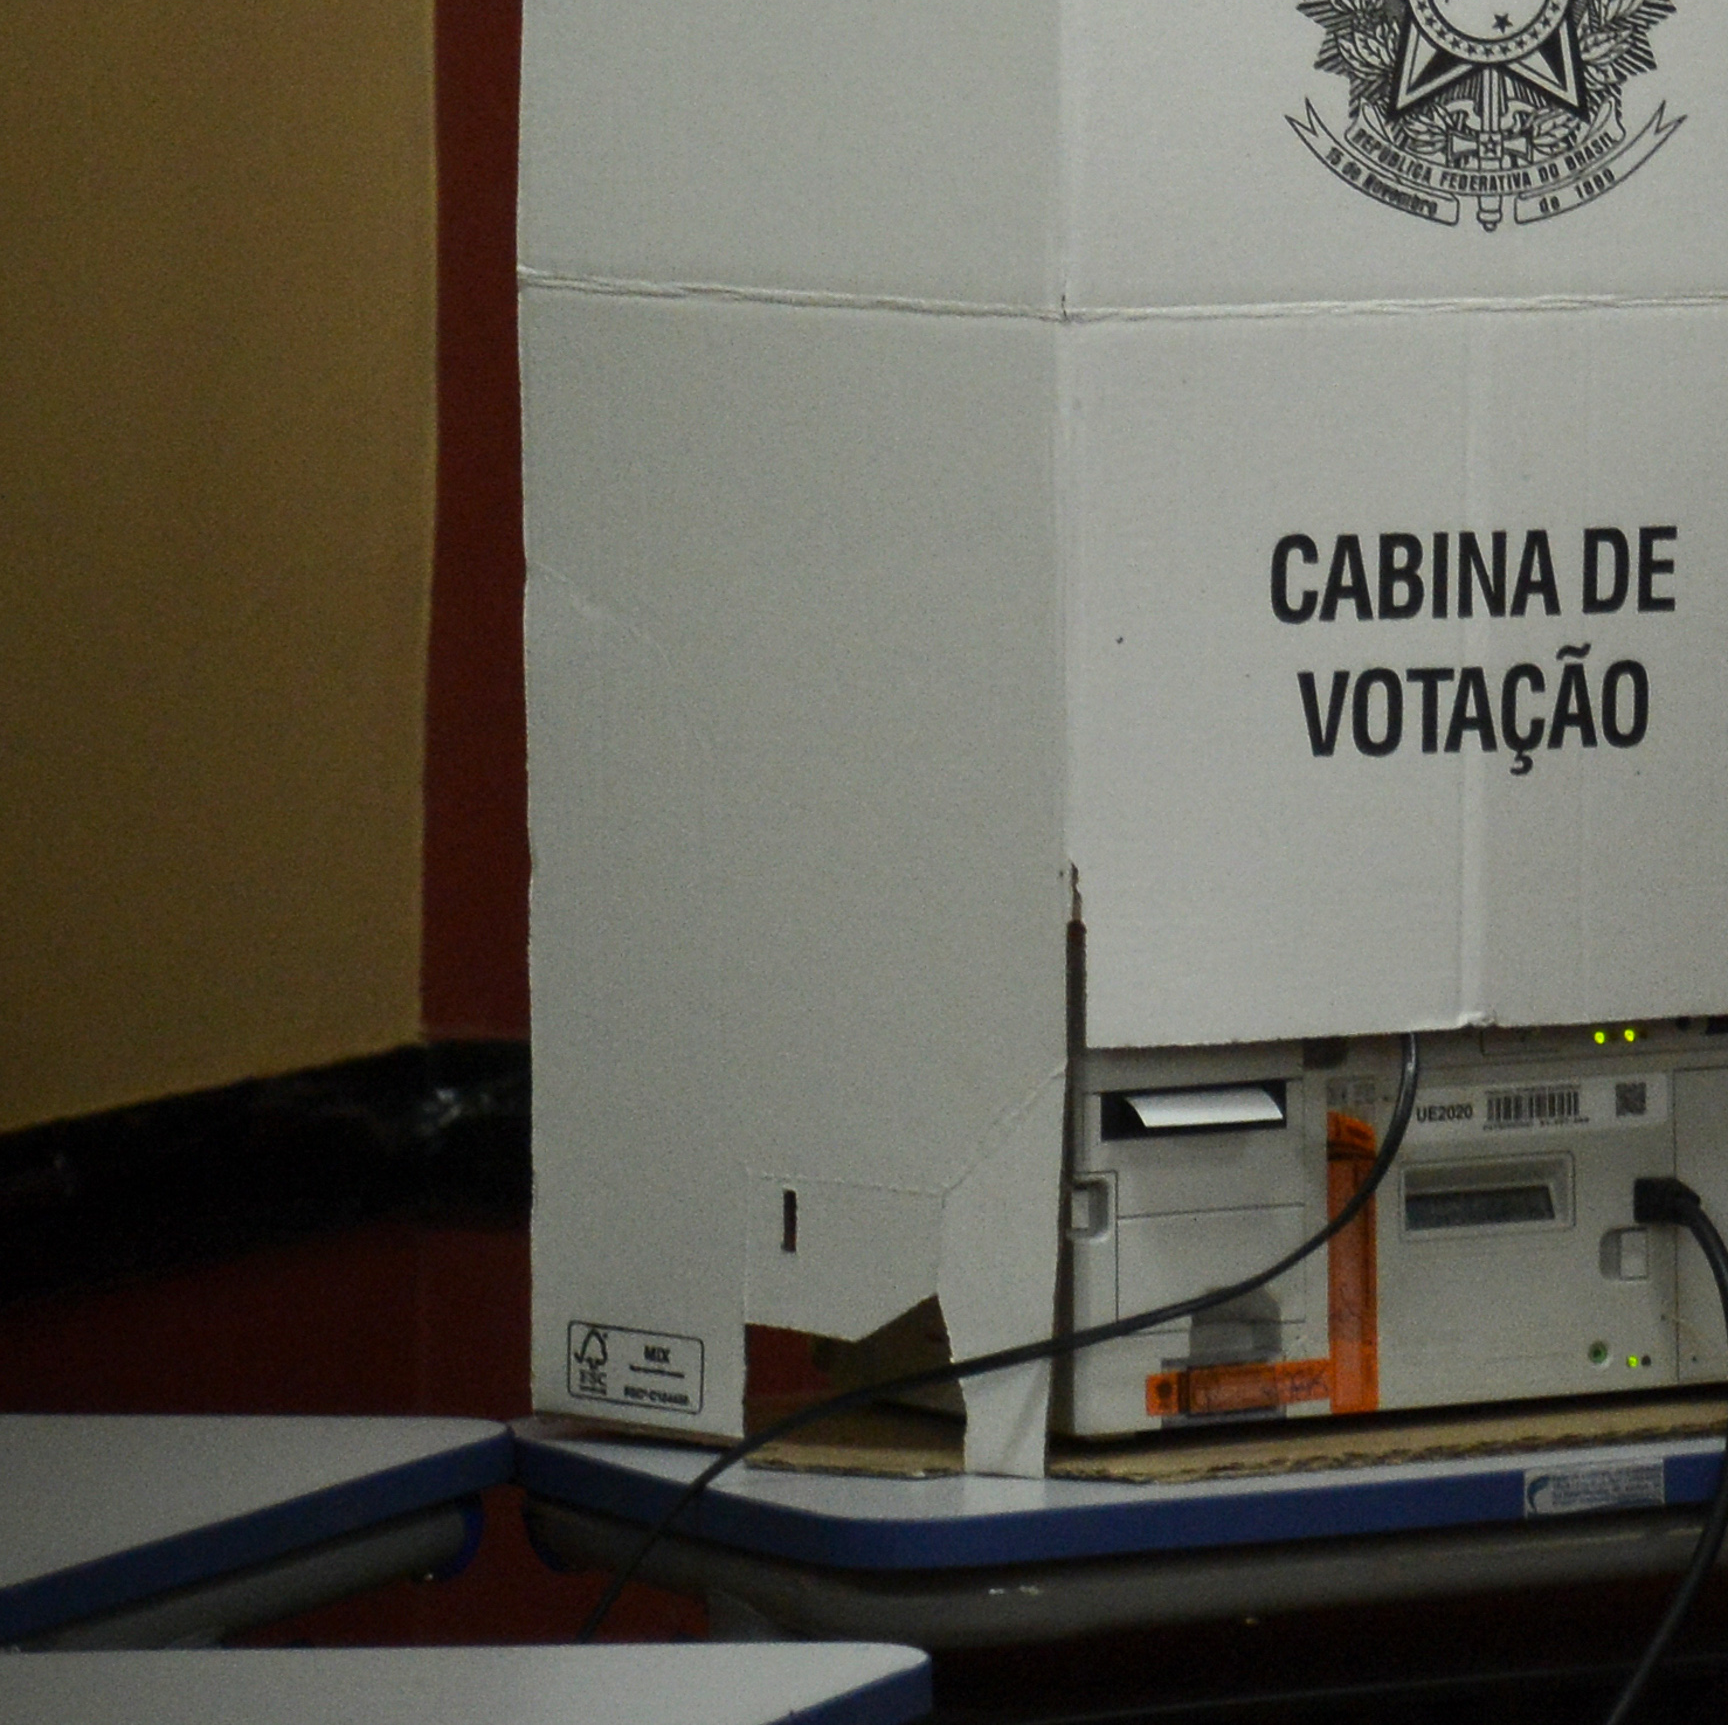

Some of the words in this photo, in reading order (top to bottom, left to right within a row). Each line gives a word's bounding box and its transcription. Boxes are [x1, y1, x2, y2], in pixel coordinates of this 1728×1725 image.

[1440, 170, 1532, 192] FEDERATIVA
[1538, 162, 1560, 183] DO
[1564, 131, 1614, 171] BRASIL
[1270, 529, 1561, 625] CABINA
[1582, 526, 1678, 615] DE
[1296, 642, 1650, 776] VOTAÇÃO
[1415, 1103, 1474, 1124] UE2020
[643, 1344, 671, 1364] MIX
